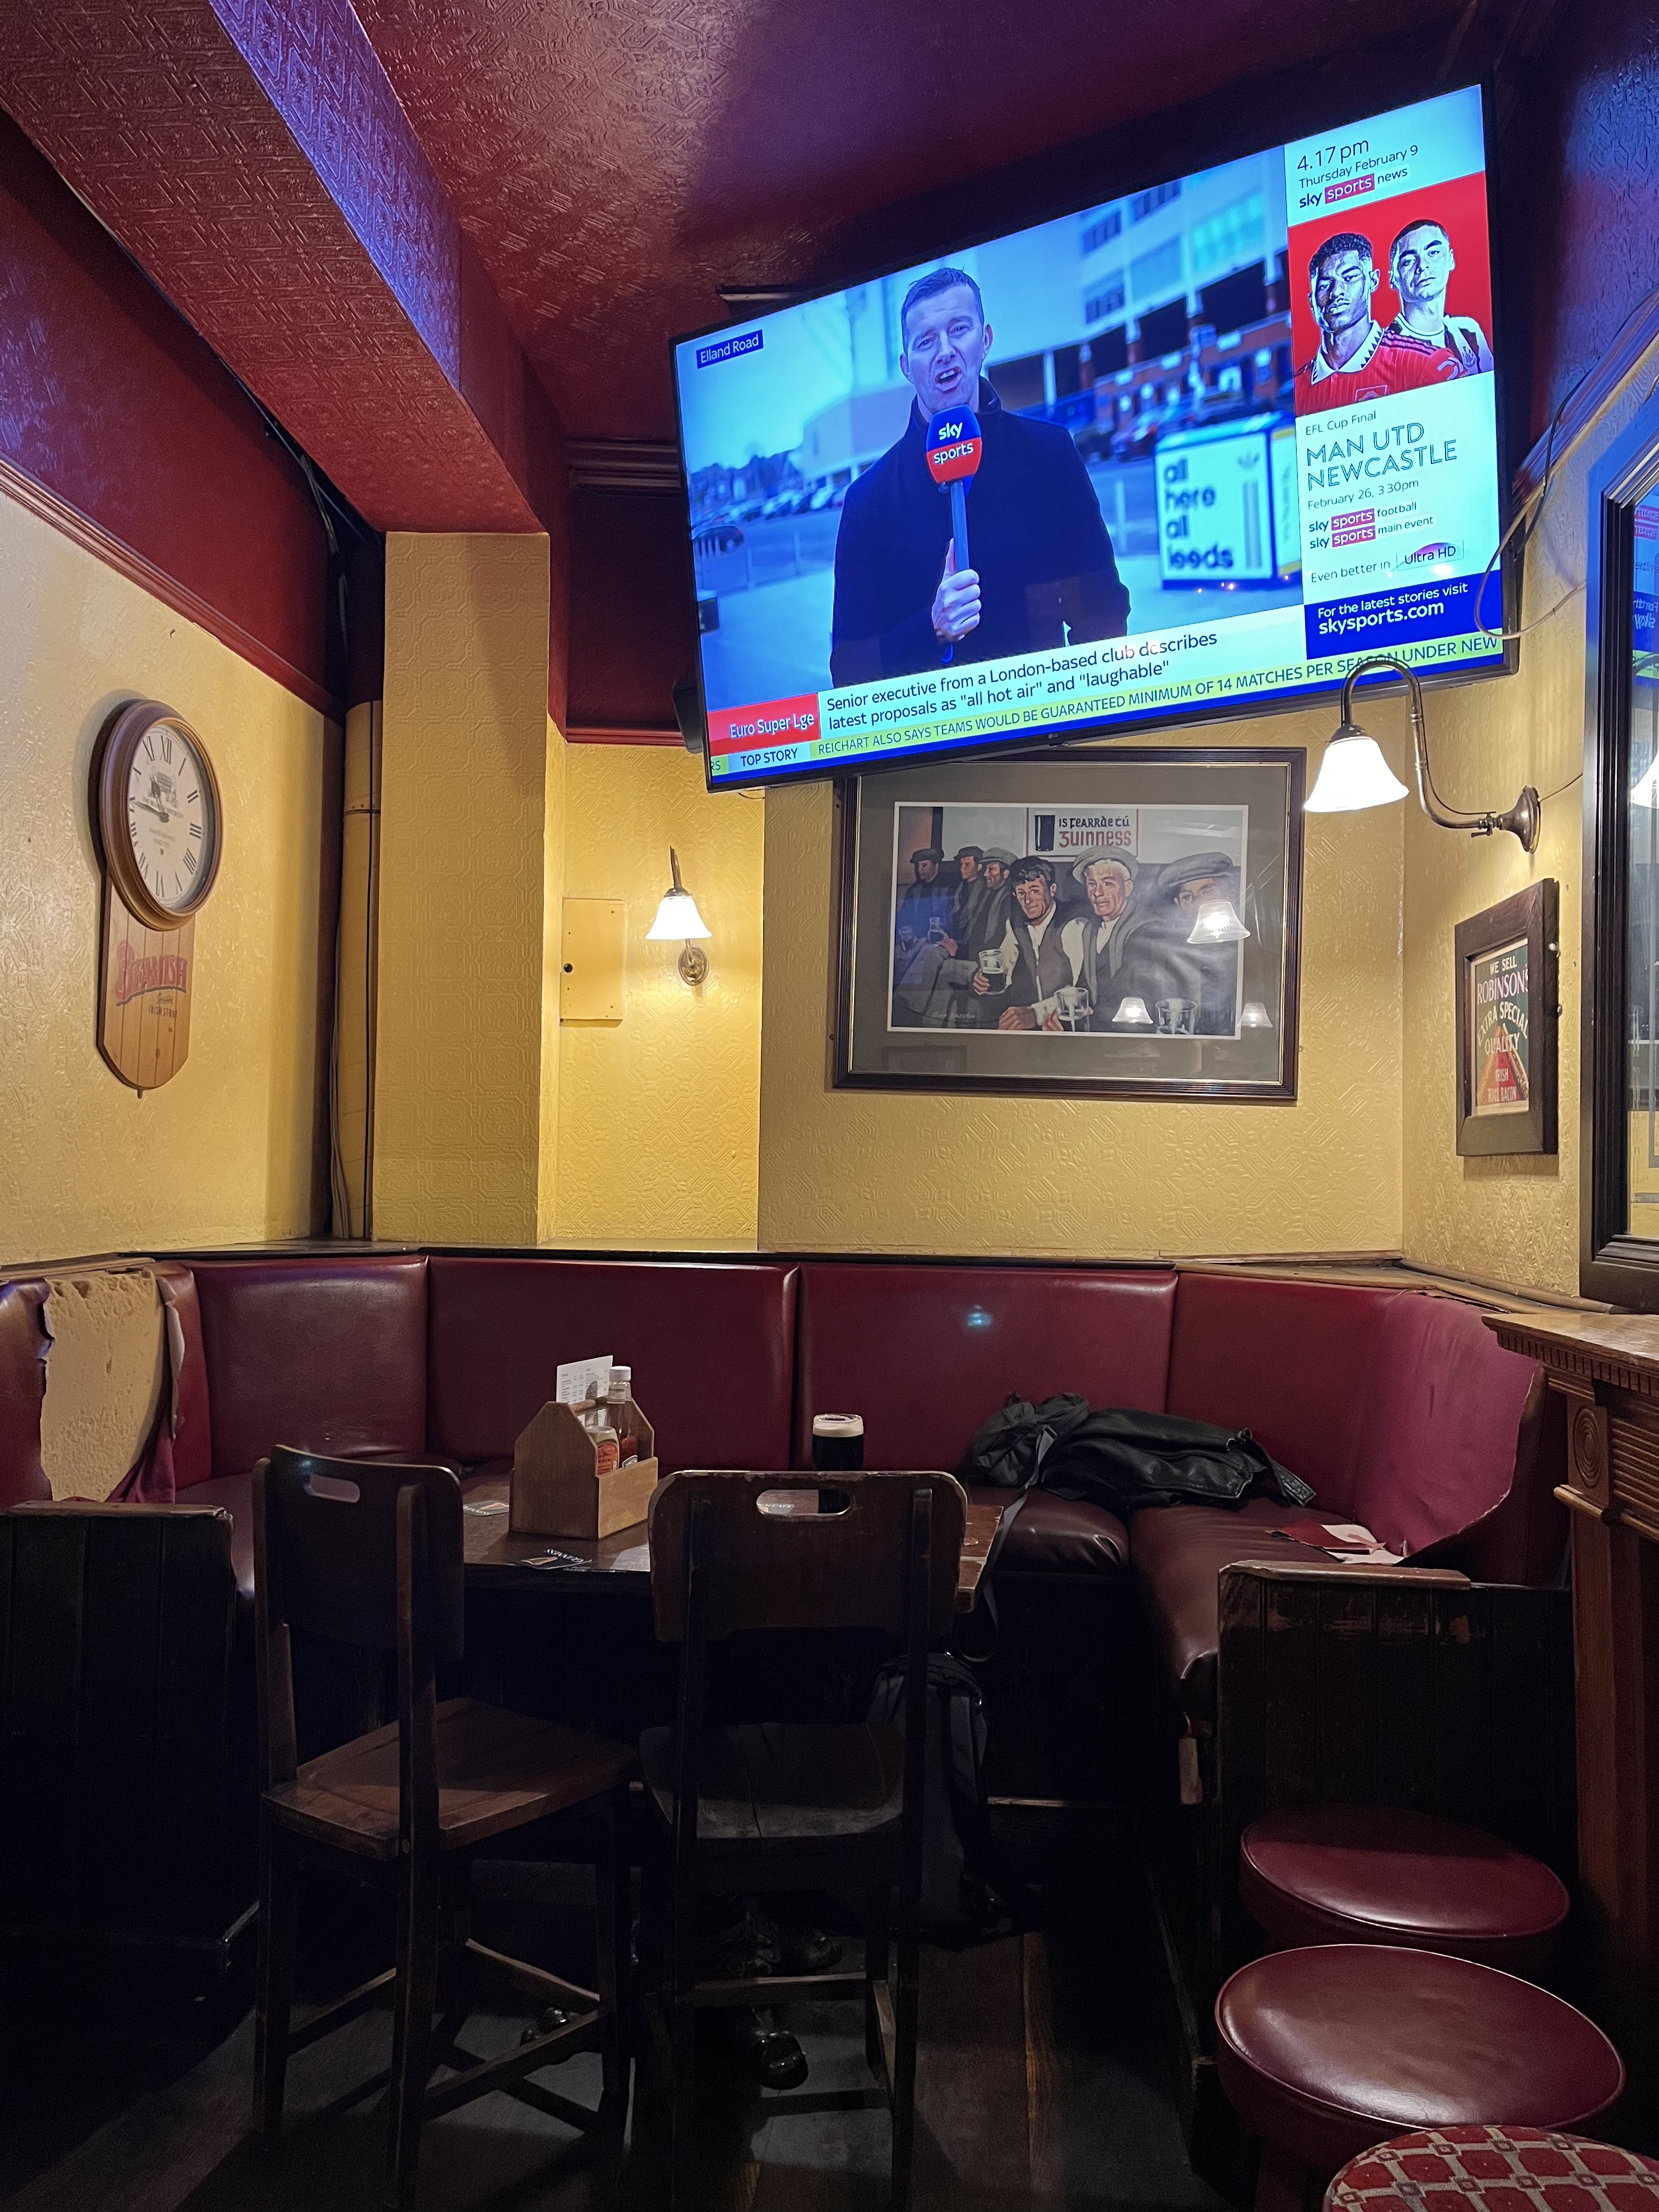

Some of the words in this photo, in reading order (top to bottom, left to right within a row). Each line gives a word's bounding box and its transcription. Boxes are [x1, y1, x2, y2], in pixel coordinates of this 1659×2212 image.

[1297, 139, 1369, 171] 4.17pm
[1299, 165, 1352, 189] Thursday
[1356, 149, 1407, 173] February
[1410, 145, 1419, 156] 9
[1299, 191, 1323, 208] sky
[1327, 177, 1372, 201] sports
[1378, 168, 1408, 184] news
[699, 342, 730, 364] Elland
[732, 335, 759, 356] Road
[939, 421, 963, 441] sky
[1306, 425, 1324, 436] EFL
[1327, 420, 1348, 432] Cup
[1352, 410, 1376, 426] Final
[934, 442, 974, 466] sports
[1307, 434, 1364, 466] MAN
[1373, 422, 1425, 450] UTD
[1308, 439, 1458, 492] NEWCASTLE
[1308, 492, 1355, 510] February
[1358, 487, 1374, 499] 26,
[1378, 479, 1419, 495] 3.30pm
[1309, 518, 1329, 533] sky
[1333, 510, 1373, 530] sports
[1377, 501, 1417, 518] football
[1310, 536, 1330, 550] sky
[1334, 527, 1374, 547] sports
[1378, 523, 1402, 535] main
[1404, 516, 1434, 529] event
[1311, 571, 1338, 583] Even
[1341, 562, 1378, 578] better
[1380, 559, 1391, 570] in
[1404, 550, 1435, 566] Ultra
[1438, 546, 1457, 560] HD
[1318, 607, 1336, 619] For
[1339, 603, 1358, 615] the
[1361, 596, 1396, 612] latest
[1398, 589, 1440, 605] stories
[1442, 582, 1469, 596] visit
[1319, 601, 1444, 636] skysports.com
[827, 693, 869, 712] Senior
[871, 681, 936, 704] executive
[940, 675, 974, 693] from
[978, 674, 986, 685] a
[991, 651, 1097, 683] London-based
[1102, 645, 1135, 664] club
[1139, 633, 1217, 657] describes
[819, 736, 870, 755] REICHART
[873, 732, 901, 747] ALSO
[904, 727, 931, 741] SAYS
[933, 720, 973, 737] TEAMS
[975, 713, 1020, 730] WOULD
[1023, 709, 1039, 722] BE
[1041, 695, 1126, 719] GUARANTEED
[1128, 684, 1193, 706] MINIMUM
[1195, 680, 1214, 695] OF
[1217, 678, 1233, 692] 14
[1236, 667, 1304, 690] MATCHES
[1306, 662, 1334, 679] PER
[1402, 642, 1457, 662] UNDER
[1462, 636, 1498, 653] NEW
[829, 713, 867, 730] latest
[871, 702, 938, 726] proposals
[941, 701, 957, 712] as
[961, 691, 984, 707] "all
[988, 687, 1013, 703] hot
[1017, 681, 1042, 698] air"
[1047, 676, 1075, 693] and
[1080, 660, 1170, 690] "laughable"
[730, 722, 755, 739] Euro
[757, 718, 790, 735] Super
[793, 713, 814, 732] Lge
[741, 753, 761, 767] TOP
[764, 748, 798, 764] STORY
[1489, 961, 1499, 975] WE
[1502, 956, 1517, 972] SELL
[1477, 1005, 1498, 1048] EXTRA
[1499, 1001, 1528, 1039] SPECIAL
[1485, 1032, 1520, 1056] QUALITY
[1496, 1068, 1509, 1082] IRISH
[1500, 1086, 1517, 1102] BACON
